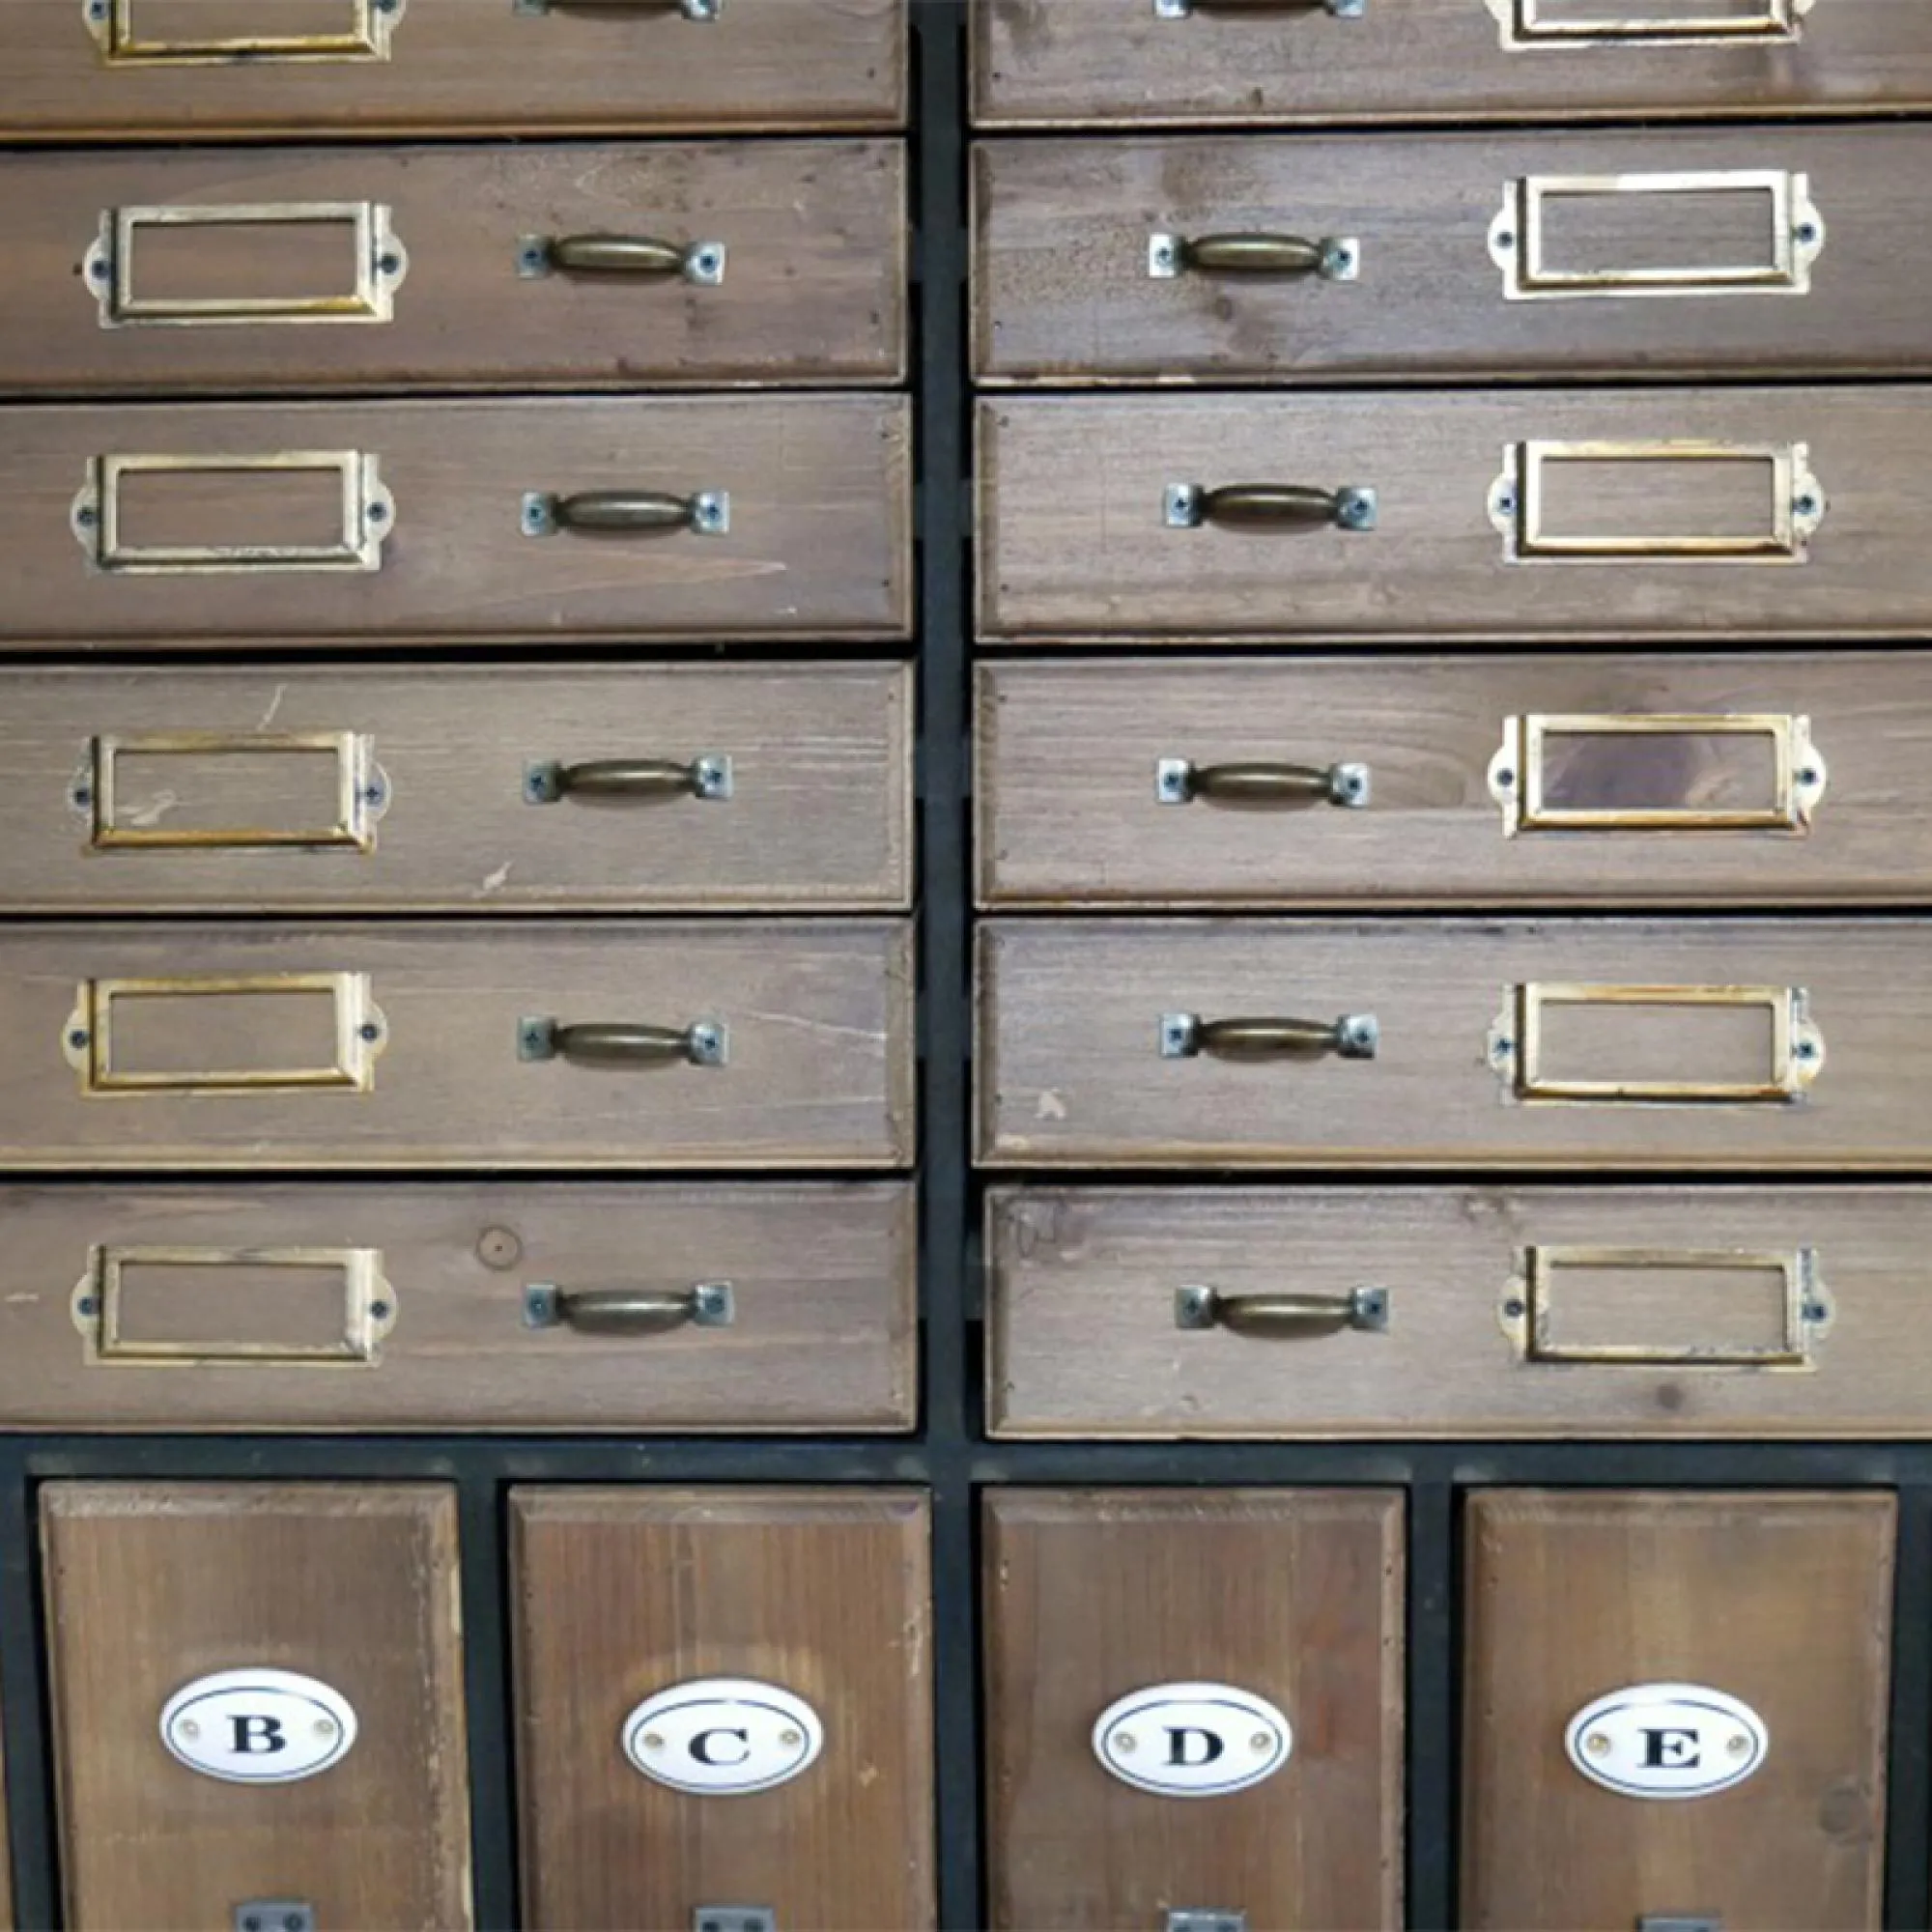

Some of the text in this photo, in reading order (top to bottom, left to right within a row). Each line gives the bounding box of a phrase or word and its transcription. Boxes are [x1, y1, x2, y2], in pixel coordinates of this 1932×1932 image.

[228, 1715, 286, 1753] B
[688, 1728, 751, 1766] C
[1163, 1727, 1225, 1766] D
[1637, 1728, 1700, 1769] E
